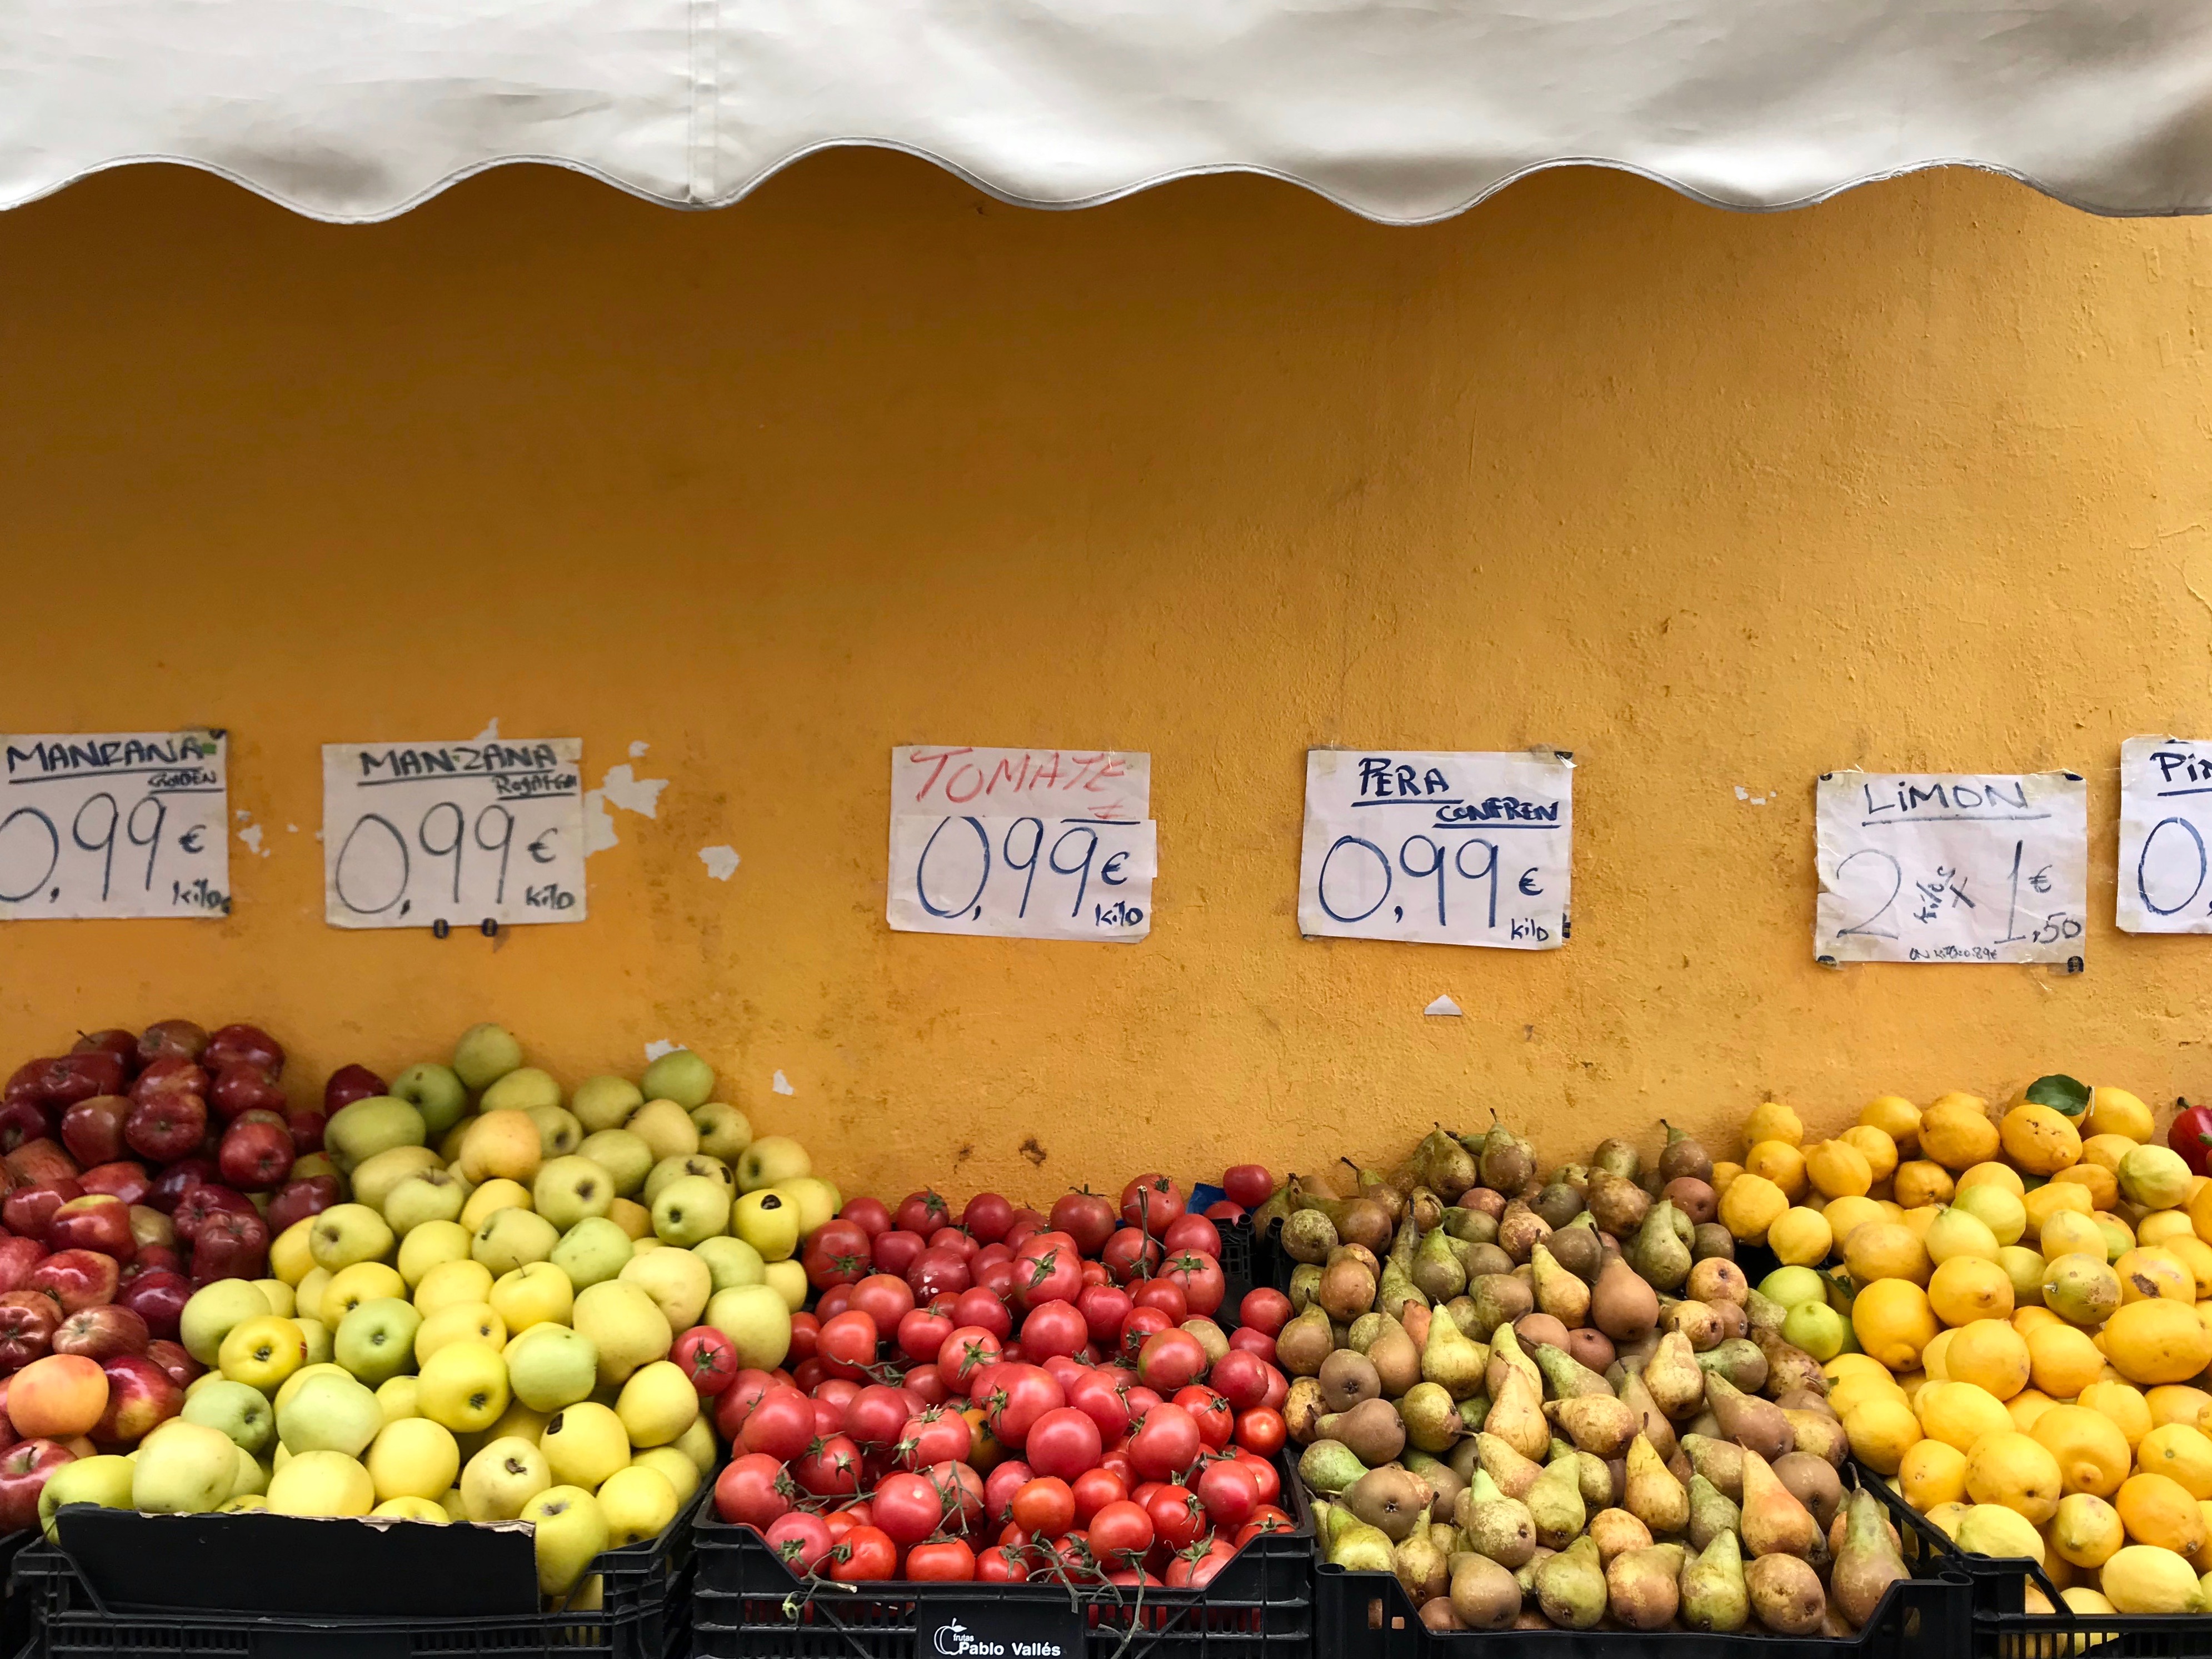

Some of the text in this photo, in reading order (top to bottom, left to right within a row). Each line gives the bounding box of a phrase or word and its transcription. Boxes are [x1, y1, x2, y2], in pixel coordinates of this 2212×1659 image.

[7, 736, 204, 773] MANZANA
[359, 743, 557, 776] MANZANA
[910, 747, 1126, 803] TOMATE
[1359, 758, 1450, 796] PERA
[179, 824, 207, 853] €
[336, 802, 557, 918] 0,99 €
[917, 816, 1130, 921] 0,99 €
[1319, 835, 1544, 928] 0,99 €
[1836, 848, 1903, 939] 2
[953, 1633, 974, 1642] frutas
[959, 1641, 1061, 1656] Pablo Vallés
